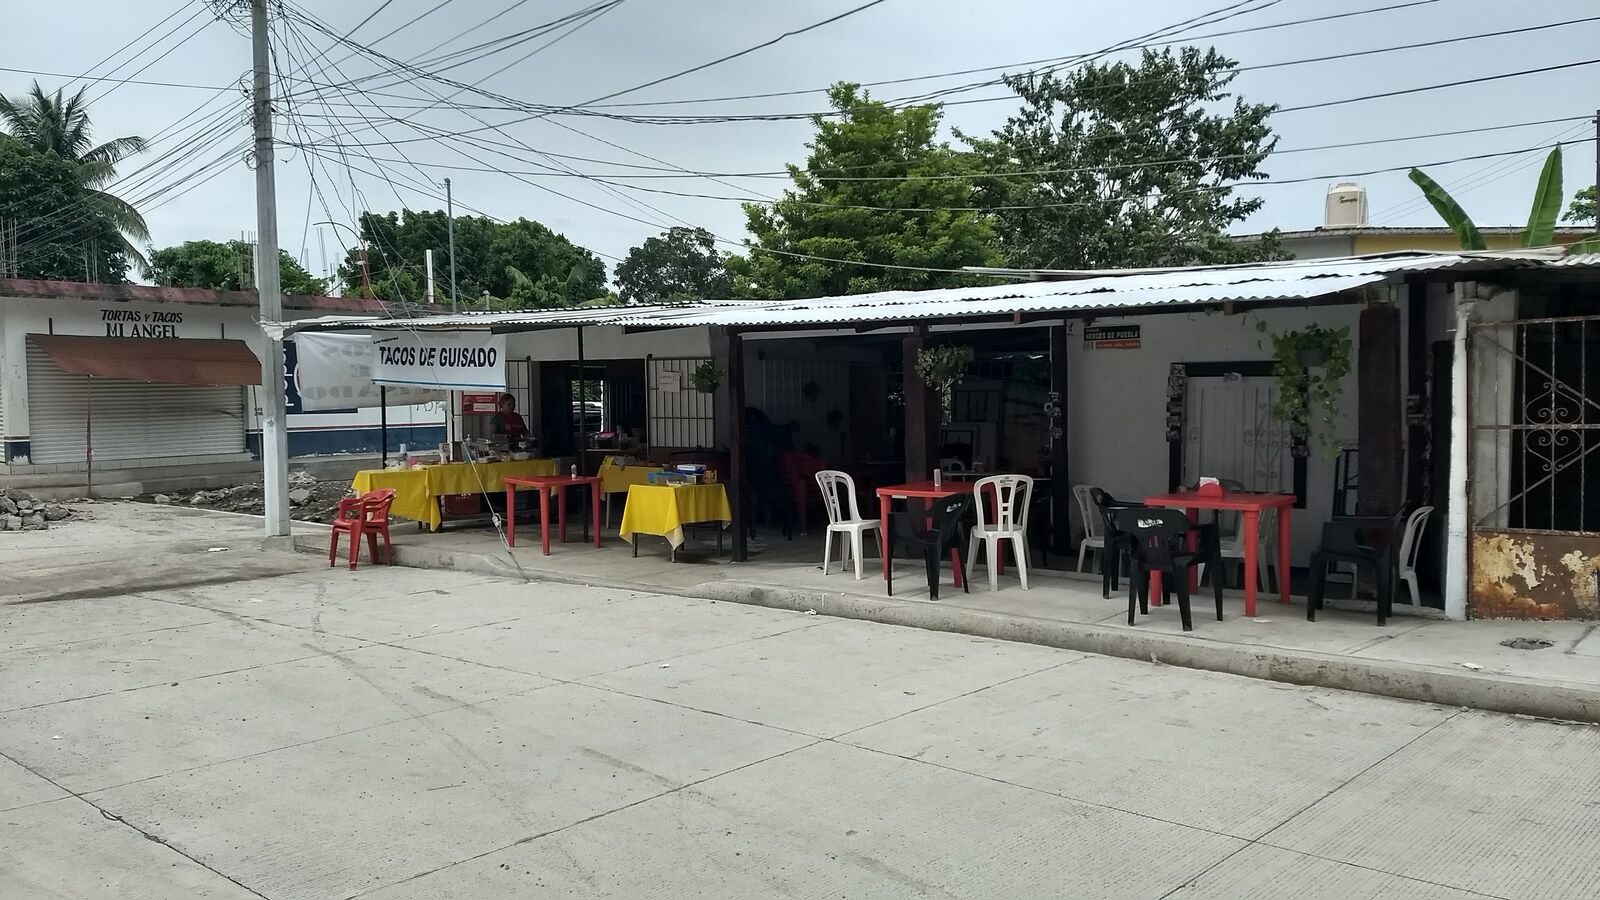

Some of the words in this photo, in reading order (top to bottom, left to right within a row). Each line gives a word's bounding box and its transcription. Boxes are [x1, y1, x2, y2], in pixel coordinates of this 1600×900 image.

[101, 309, 141, 322] TORTAS
[152, 311, 183, 323] TACOS
[106, 323, 124, 338] MI
[131, 324, 179, 339] ANGEL
[1085, 332, 1106, 340] HEROES
[379, 346, 416, 366] TACOS
[419, 347, 437, 367] DE
[438, 347, 498, 368] GUISADO
